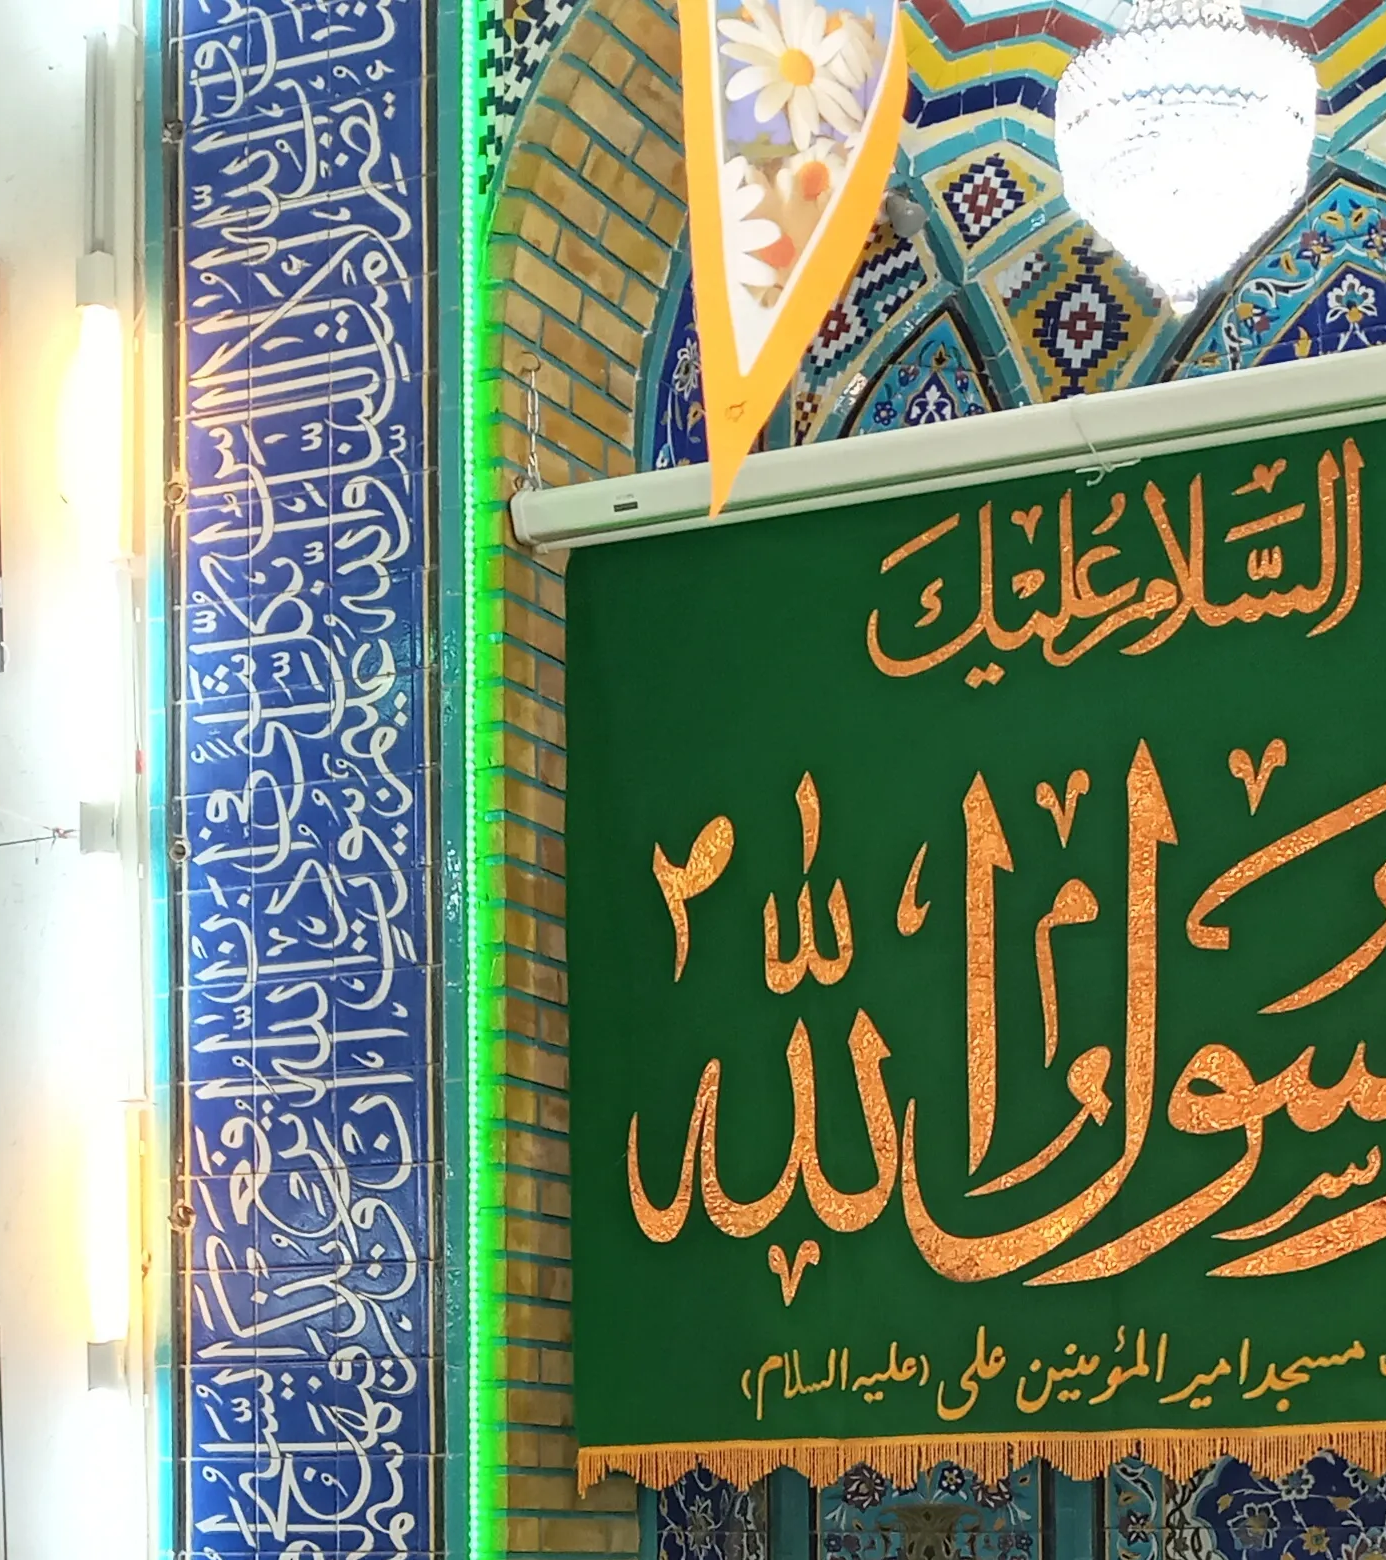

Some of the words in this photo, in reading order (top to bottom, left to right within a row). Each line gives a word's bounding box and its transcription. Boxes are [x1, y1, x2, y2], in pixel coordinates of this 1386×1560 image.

[867, 488, 1140, 689] علیک
[1043, 437, 1366, 667] السلام
[627, 771, 1014, 1241] الله
[937, 1325, 1006, 1422] علی
[1158, 1337, 1250, 1409] امیر
[1248, 1338, 1367, 1412] مسجد
